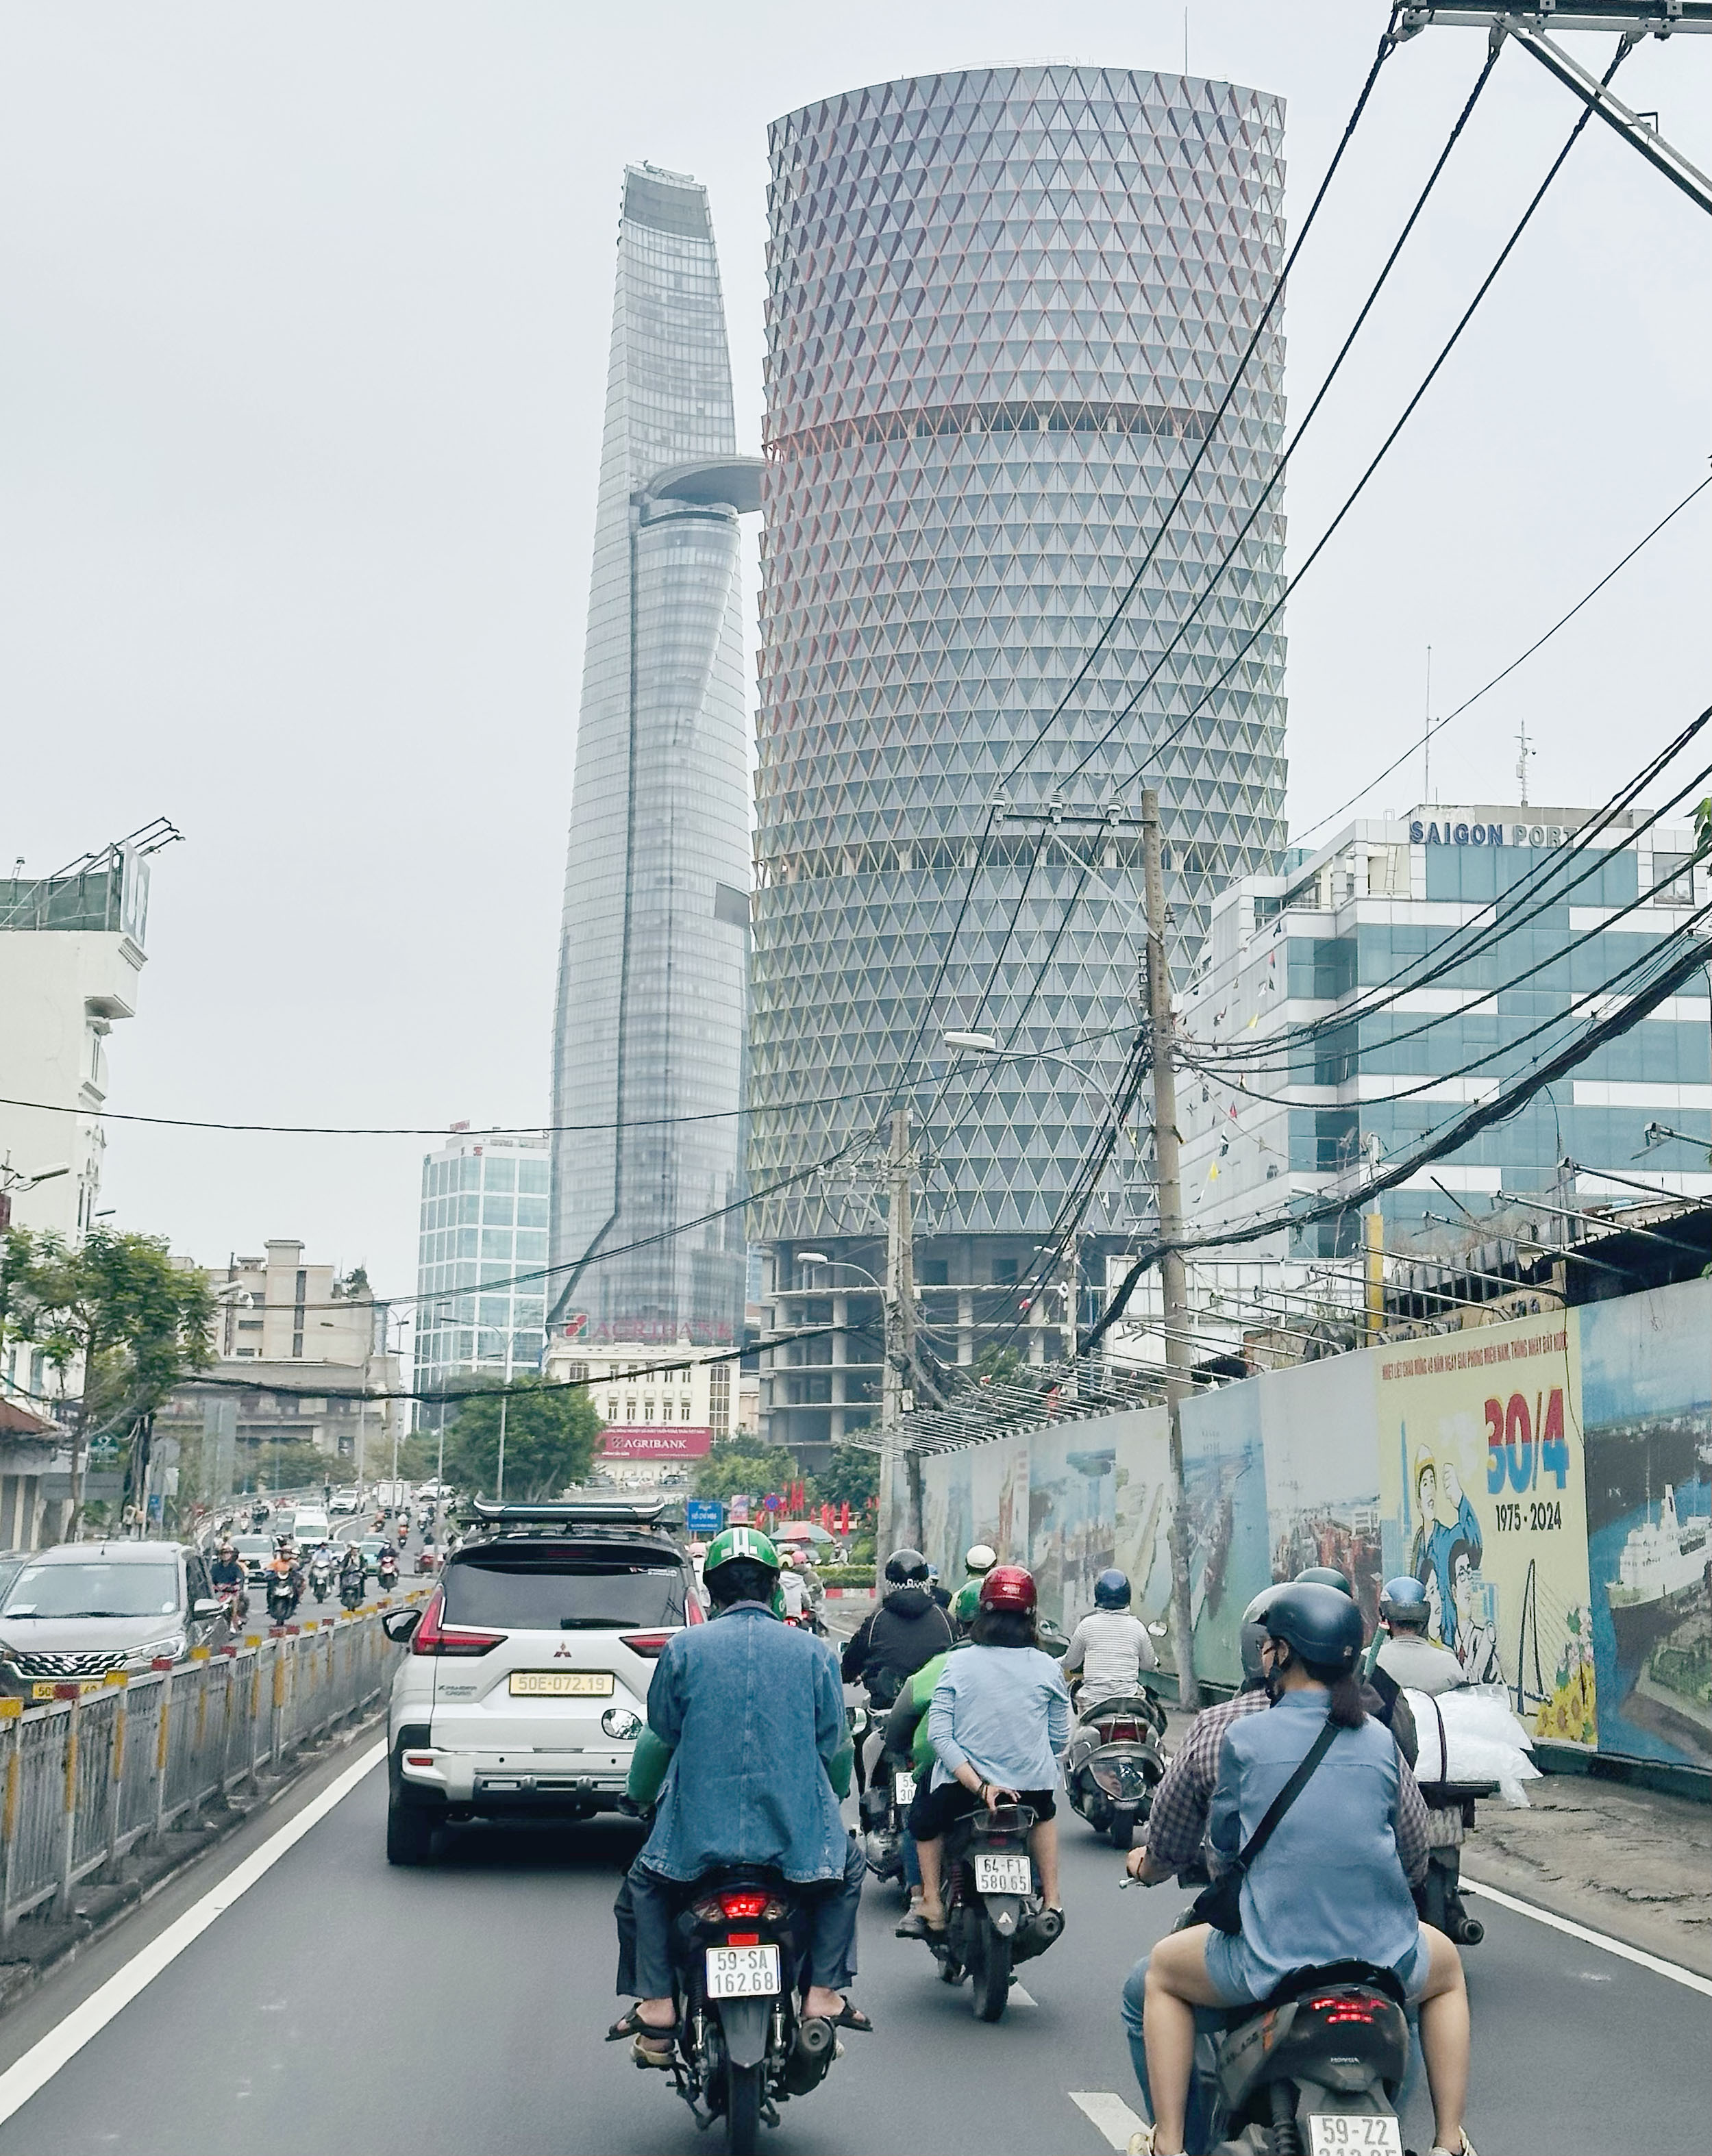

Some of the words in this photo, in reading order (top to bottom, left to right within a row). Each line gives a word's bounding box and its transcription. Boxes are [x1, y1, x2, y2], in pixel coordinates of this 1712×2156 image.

[1409, 820, 1503, 847] SAIGON
[1512, 825, 1578, 848] PORT
[624, 1439, 687, 1449] AGRIBANK
[1484, 1388, 1570, 1495] 30/4
[519, 1677, 604, 1690] 50E-072.19
[984, 1858, 1021, 1873] 64-F1
[717, 1950, 767, 1970] 59-SA
[715, 1971, 773, 1994] 162.68
[1322, 2118, 1389, 2145] 59-Z2
